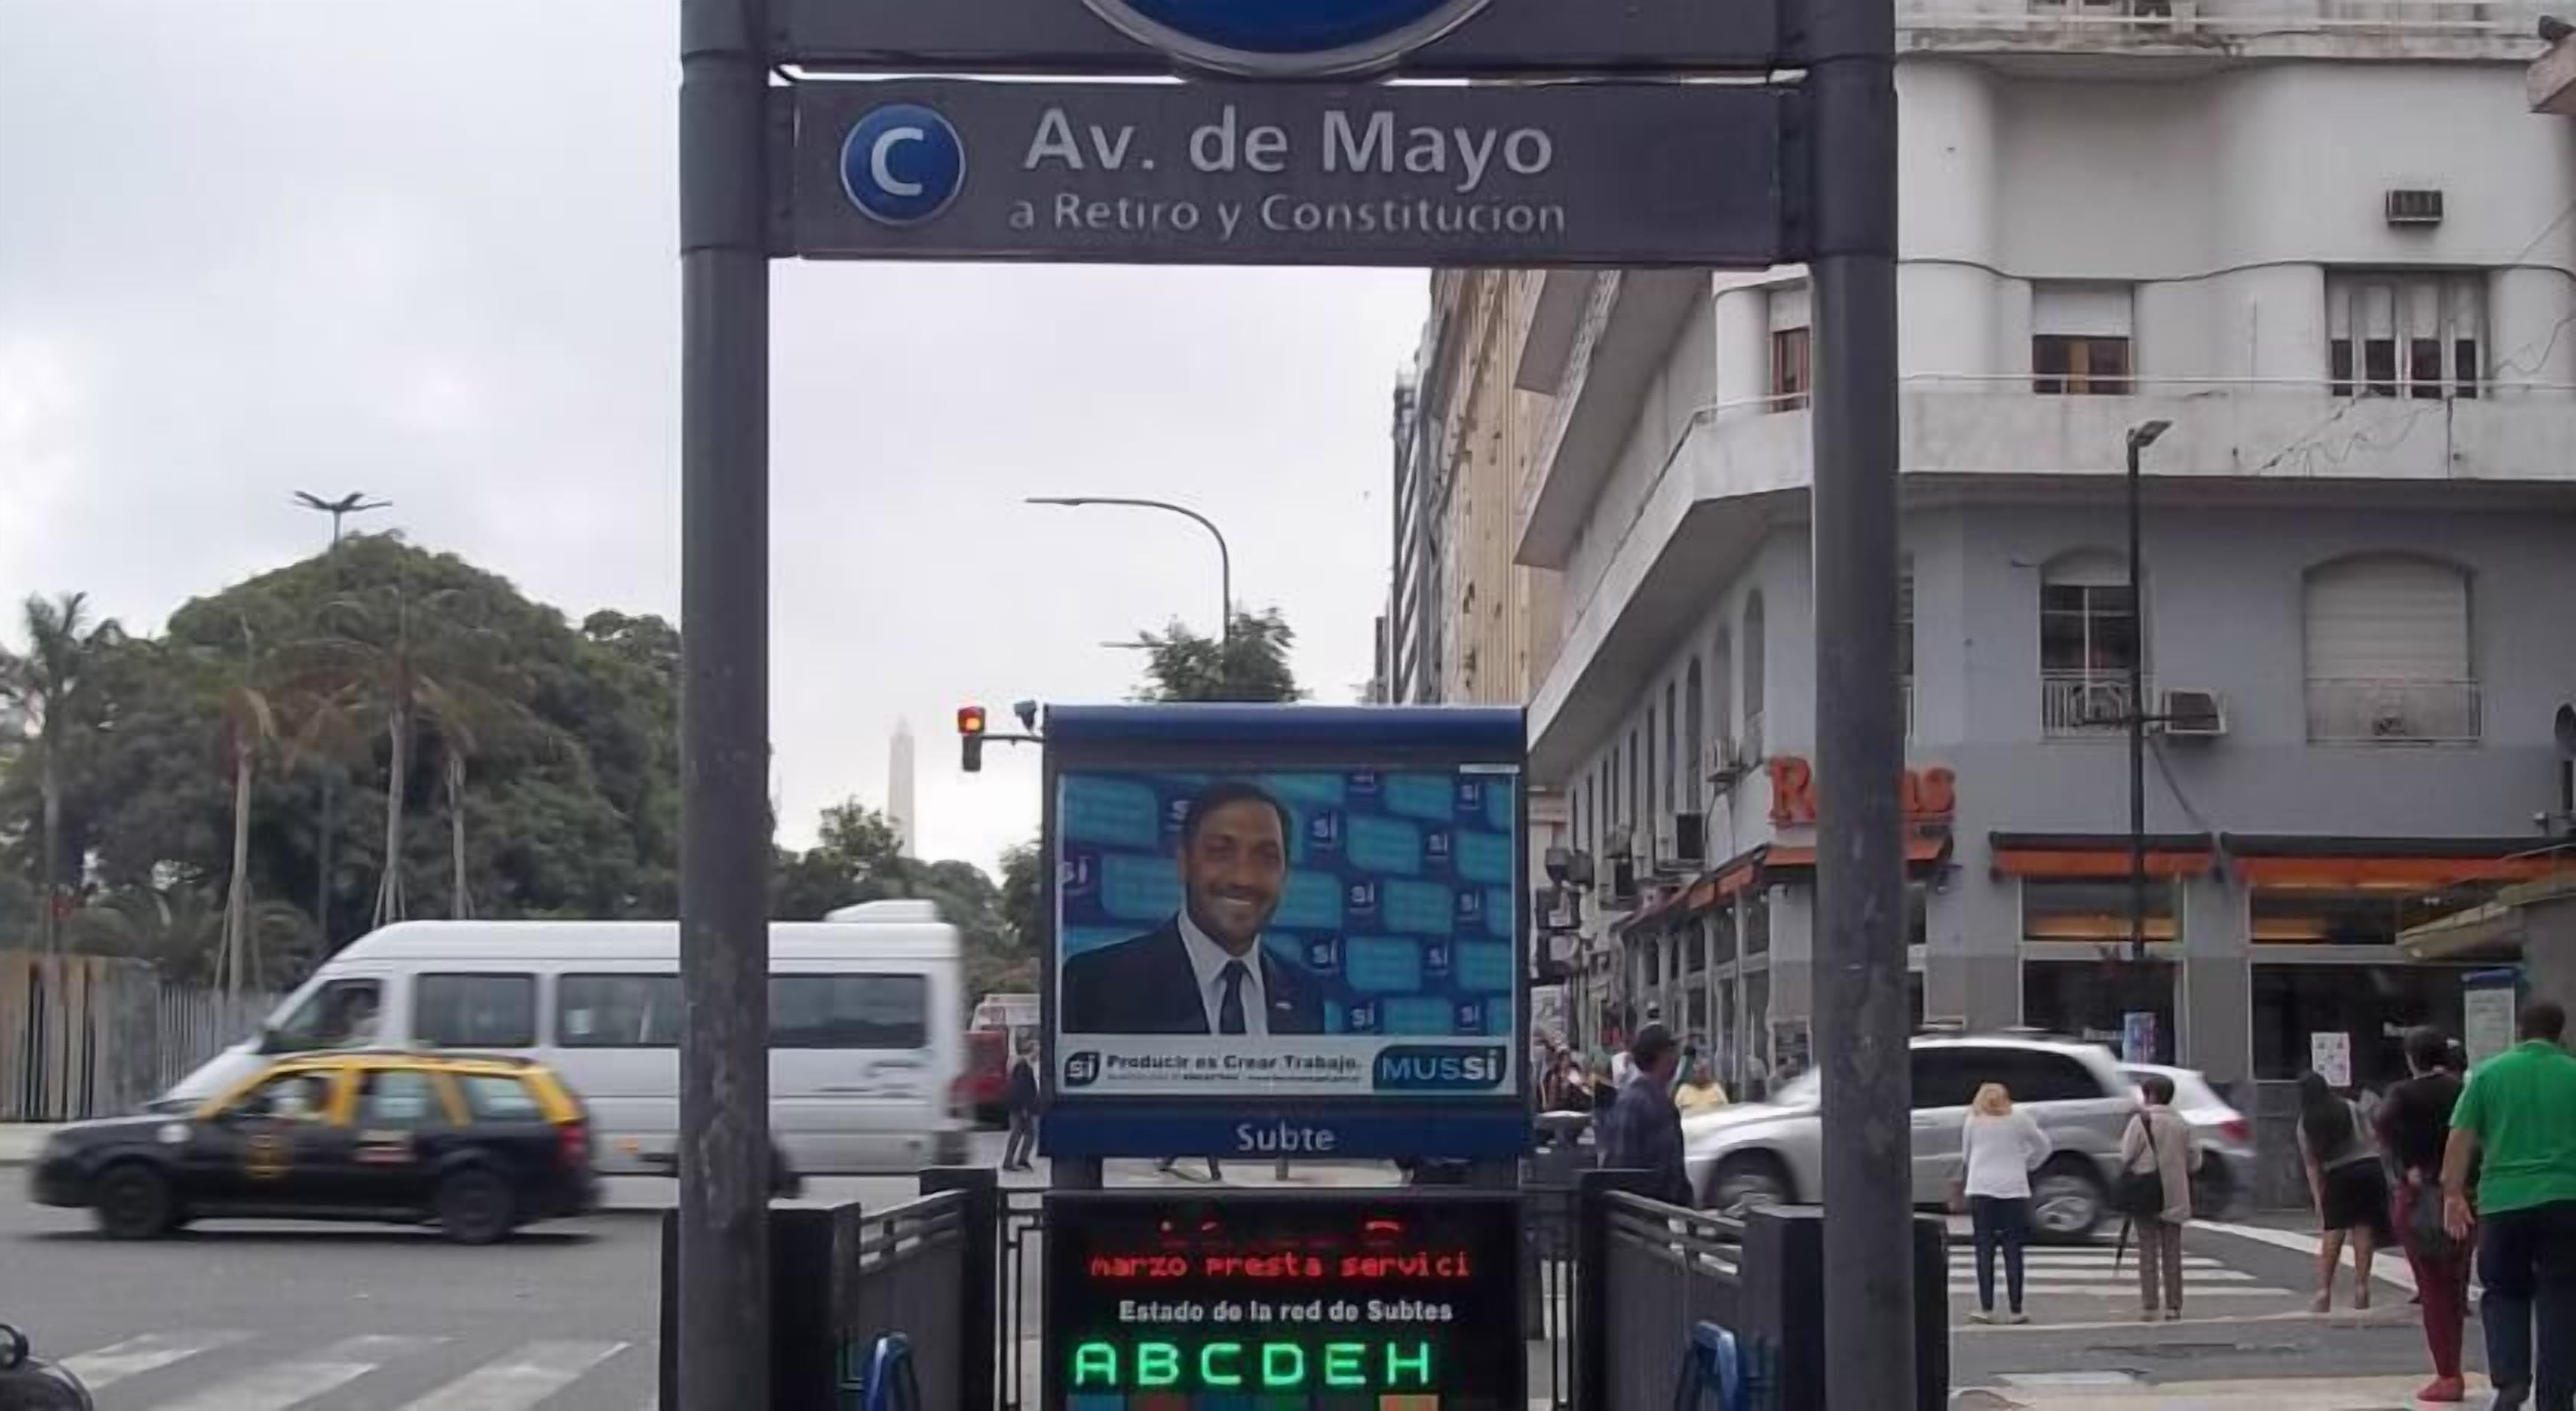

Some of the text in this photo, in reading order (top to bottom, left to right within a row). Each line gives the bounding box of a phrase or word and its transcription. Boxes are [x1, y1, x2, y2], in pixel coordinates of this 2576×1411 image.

[871, 127, 924, 196] C
[1024, 104, 1552, 194] Av. de Mayo
[1008, 199, 1035, 229] a
[1054, 193, 1200, 229] Retiro
[1217, 202, 1242, 239] y
[1236, 1120, 1335, 1151] Subte
[1090, 1251, 1470, 1277] marzo presta servici
[1119, 1299, 1453, 1322] Estado de la red de Subtes
